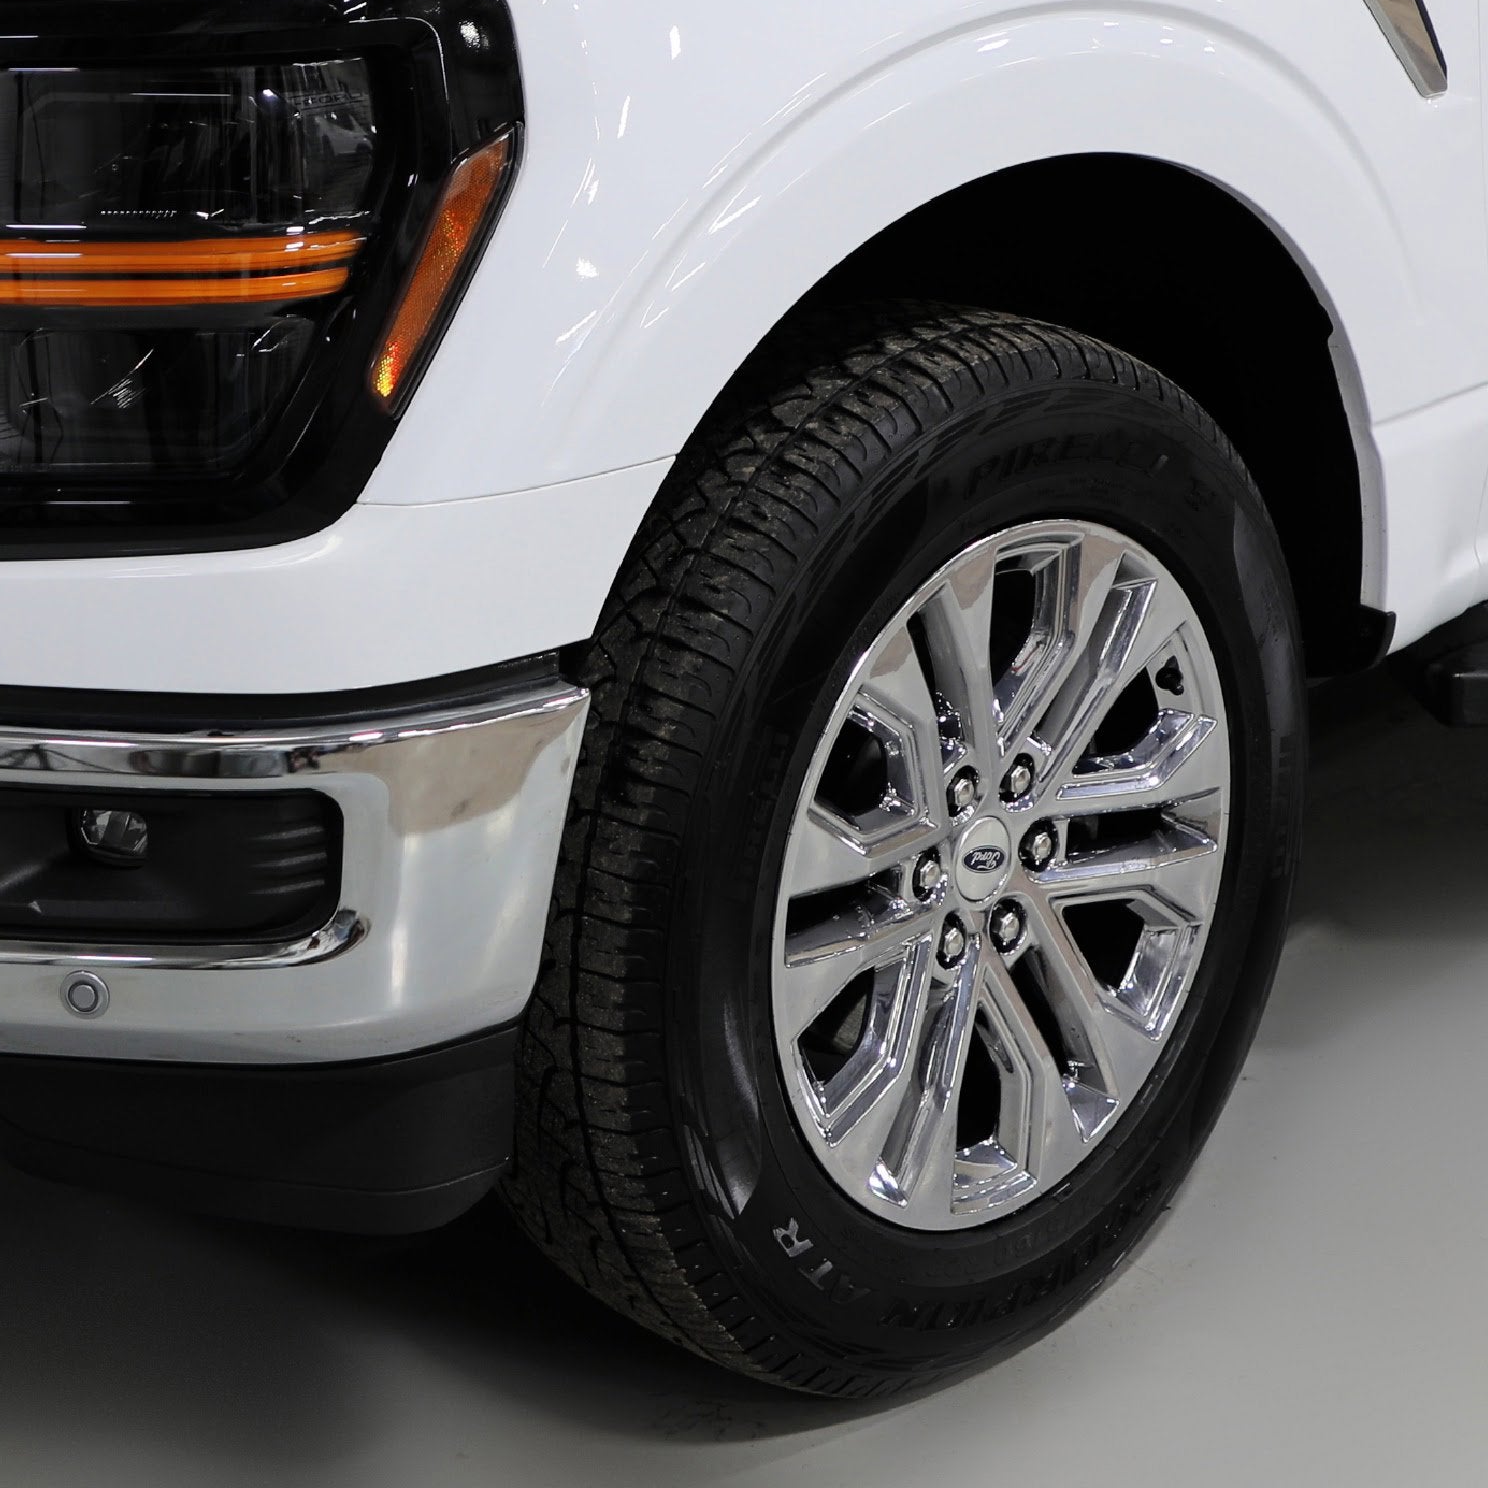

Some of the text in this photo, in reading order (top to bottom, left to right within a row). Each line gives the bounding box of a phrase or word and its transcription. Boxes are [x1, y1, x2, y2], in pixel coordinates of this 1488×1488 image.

[964, 426, 1172, 500] PIRELLI
[970, 851, 1001, 870] Ford
[770, 1216, 873, 1306] ATR
